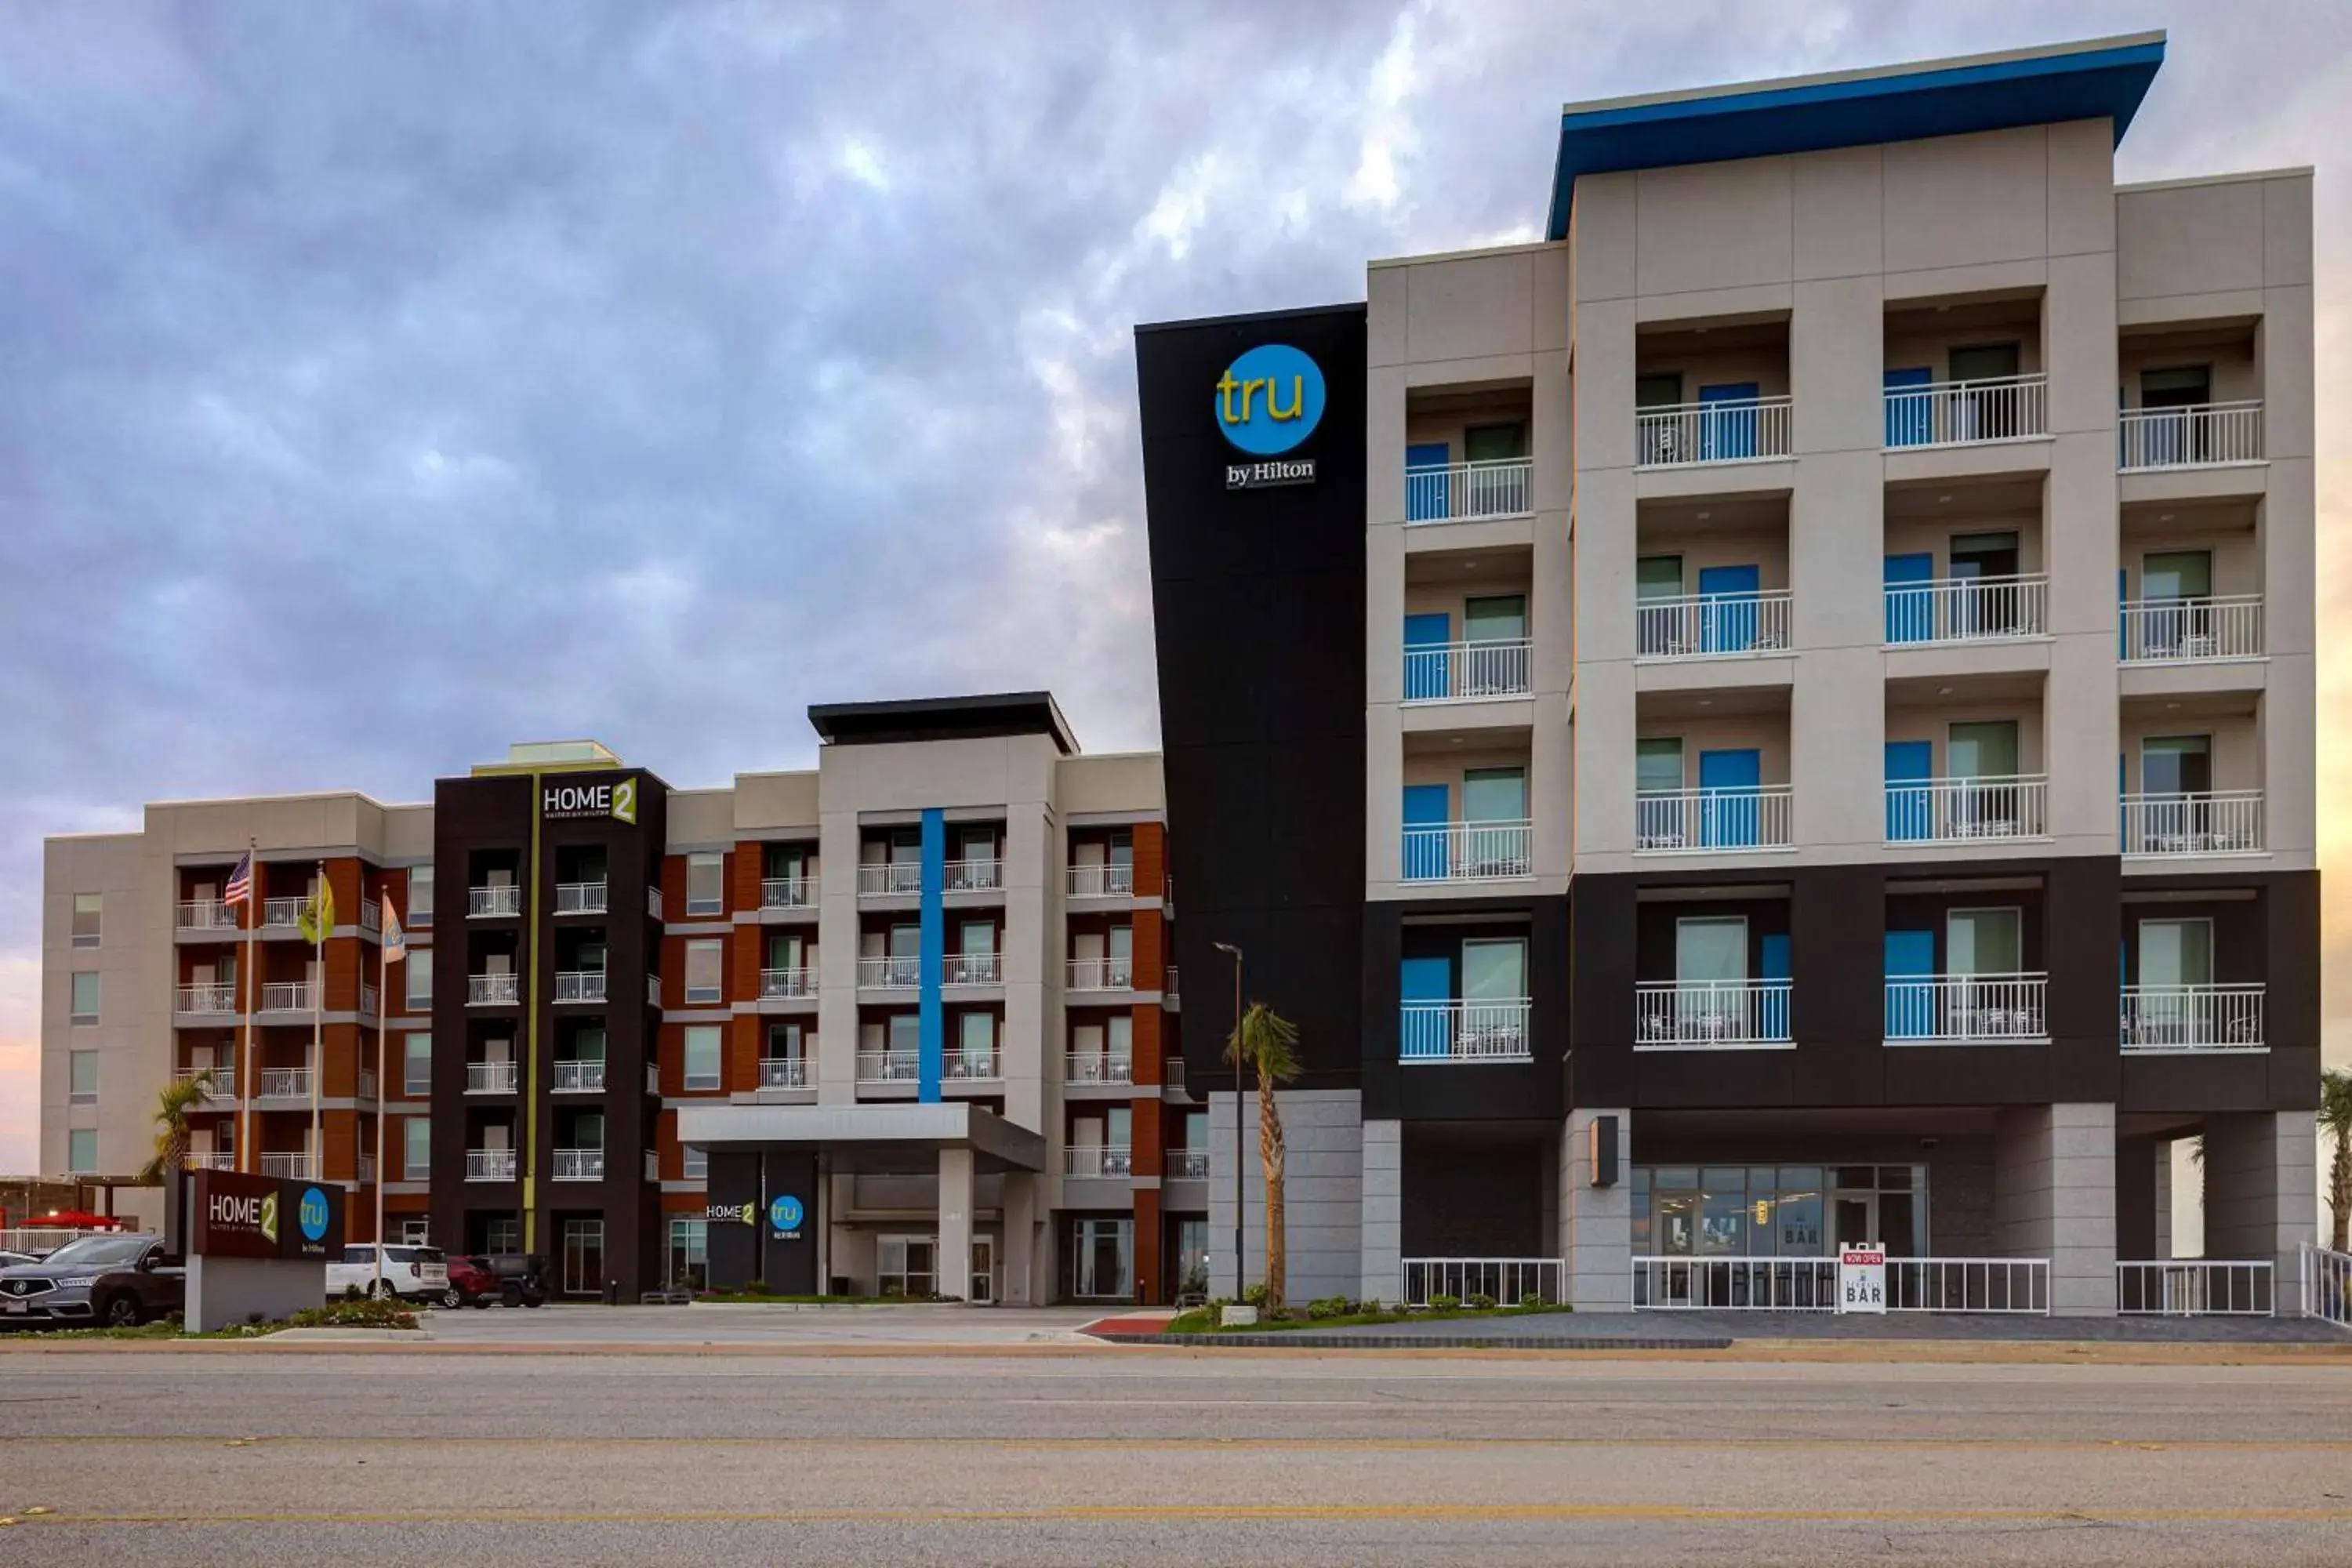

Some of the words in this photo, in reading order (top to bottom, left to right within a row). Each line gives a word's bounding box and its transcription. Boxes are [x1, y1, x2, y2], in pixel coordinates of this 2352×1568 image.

[1216, 368, 1302, 423] tru
[1228, 466, 1250, 486] by
[1254, 461, 1314, 481] Hilton
[300, 1198, 322, 1226] tru
[771, 1203, 795, 1221] tru
[1785, 1230, 1817, 1245] BAR
[1846, 1287, 1881, 1303] BAR
